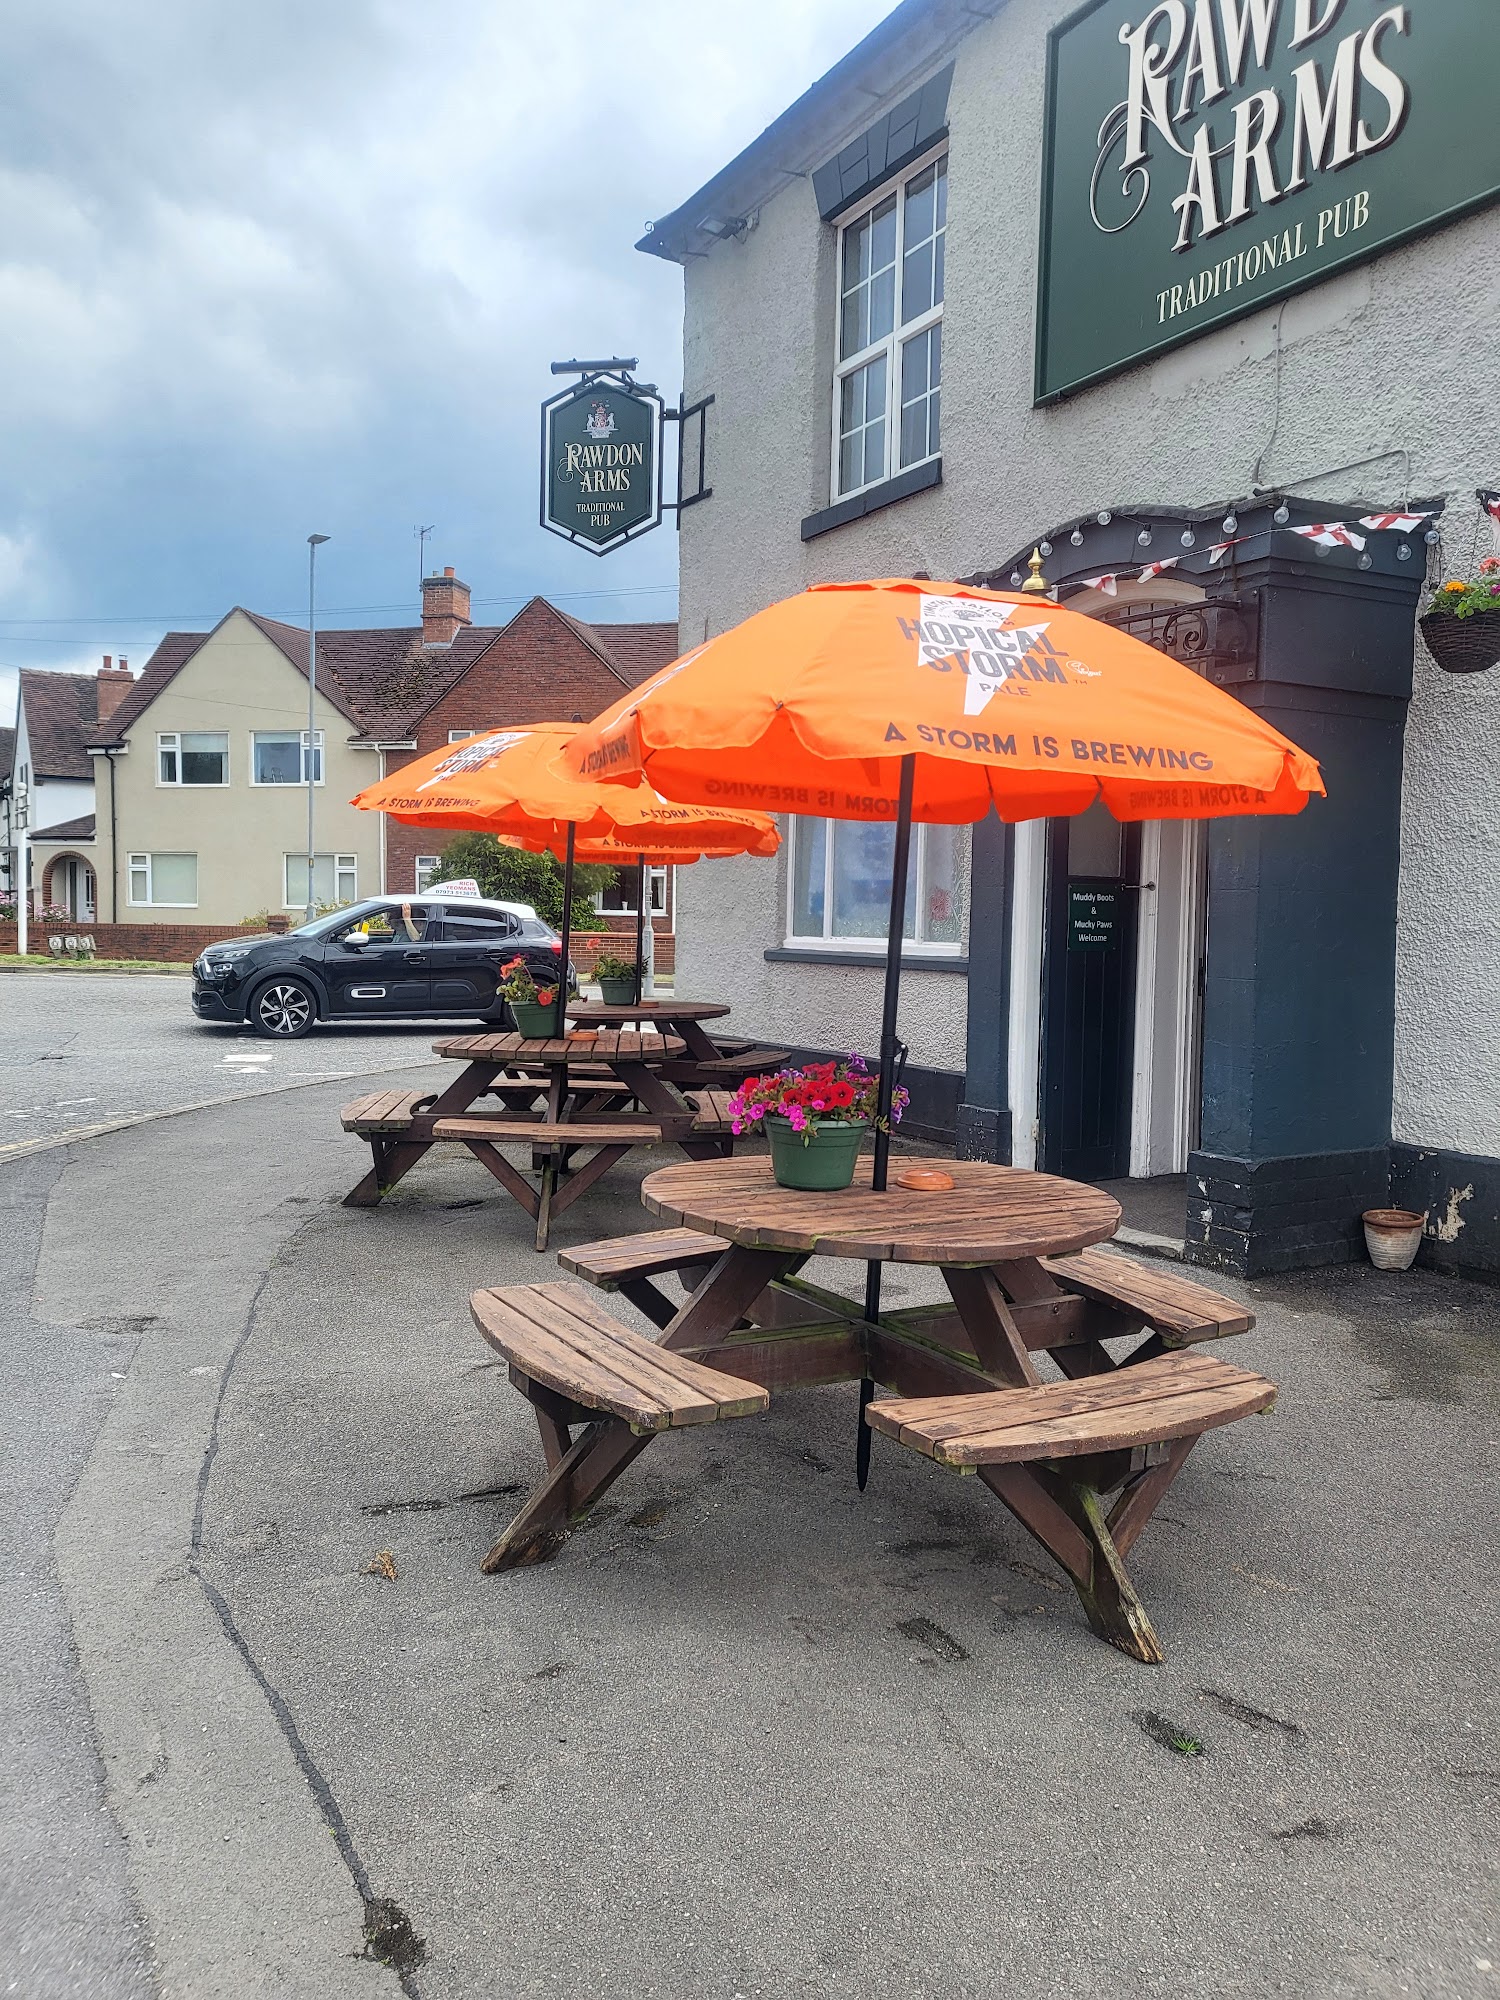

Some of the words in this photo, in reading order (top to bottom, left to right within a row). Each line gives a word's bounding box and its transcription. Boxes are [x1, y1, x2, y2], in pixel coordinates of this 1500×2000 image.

[1171, 6, 1405, 252] ARMS
[1156, 222, 1307, 324] TRADITIONAL
[1315, 190, 1370, 249] PUB
[557, 442, 645, 483] RAWDON
[580, 469, 630, 493] ARMS
[576, 501, 625, 513] TRADITIONAL
[591, 515, 611, 527] PUB
[923, 600, 954, 618] TIMOTHY
[896, 616, 1069, 657] HOPICAL
[922, 645, 1068, 684] STORM
[979, 682, 1032, 697] PALE
[884, 722, 906, 742] A
[917, 724, 1017, 755] STORM
[1033, 736, 1060, 758] IS
[1071, 740, 1214, 771] BREWING
[434, 759, 489, 774] STORM
[377, 798, 387, 806] A
[389, 798, 422, 809] STORM
[424, 798, 434, 807] IS
[434, 798, 481, 807] BREWING
[650, 809, 690, 819] STORM
[1073, 893, 1096, 903] Muddy
[1097, 893, 1115, 902] Boots
[1091, 906, 1097, 915] &
[1074, 920, 1096, 930] Mucky
[1096, 920, 1113, 929] Paws
[1078, 933, 1107, 941] Welcome
